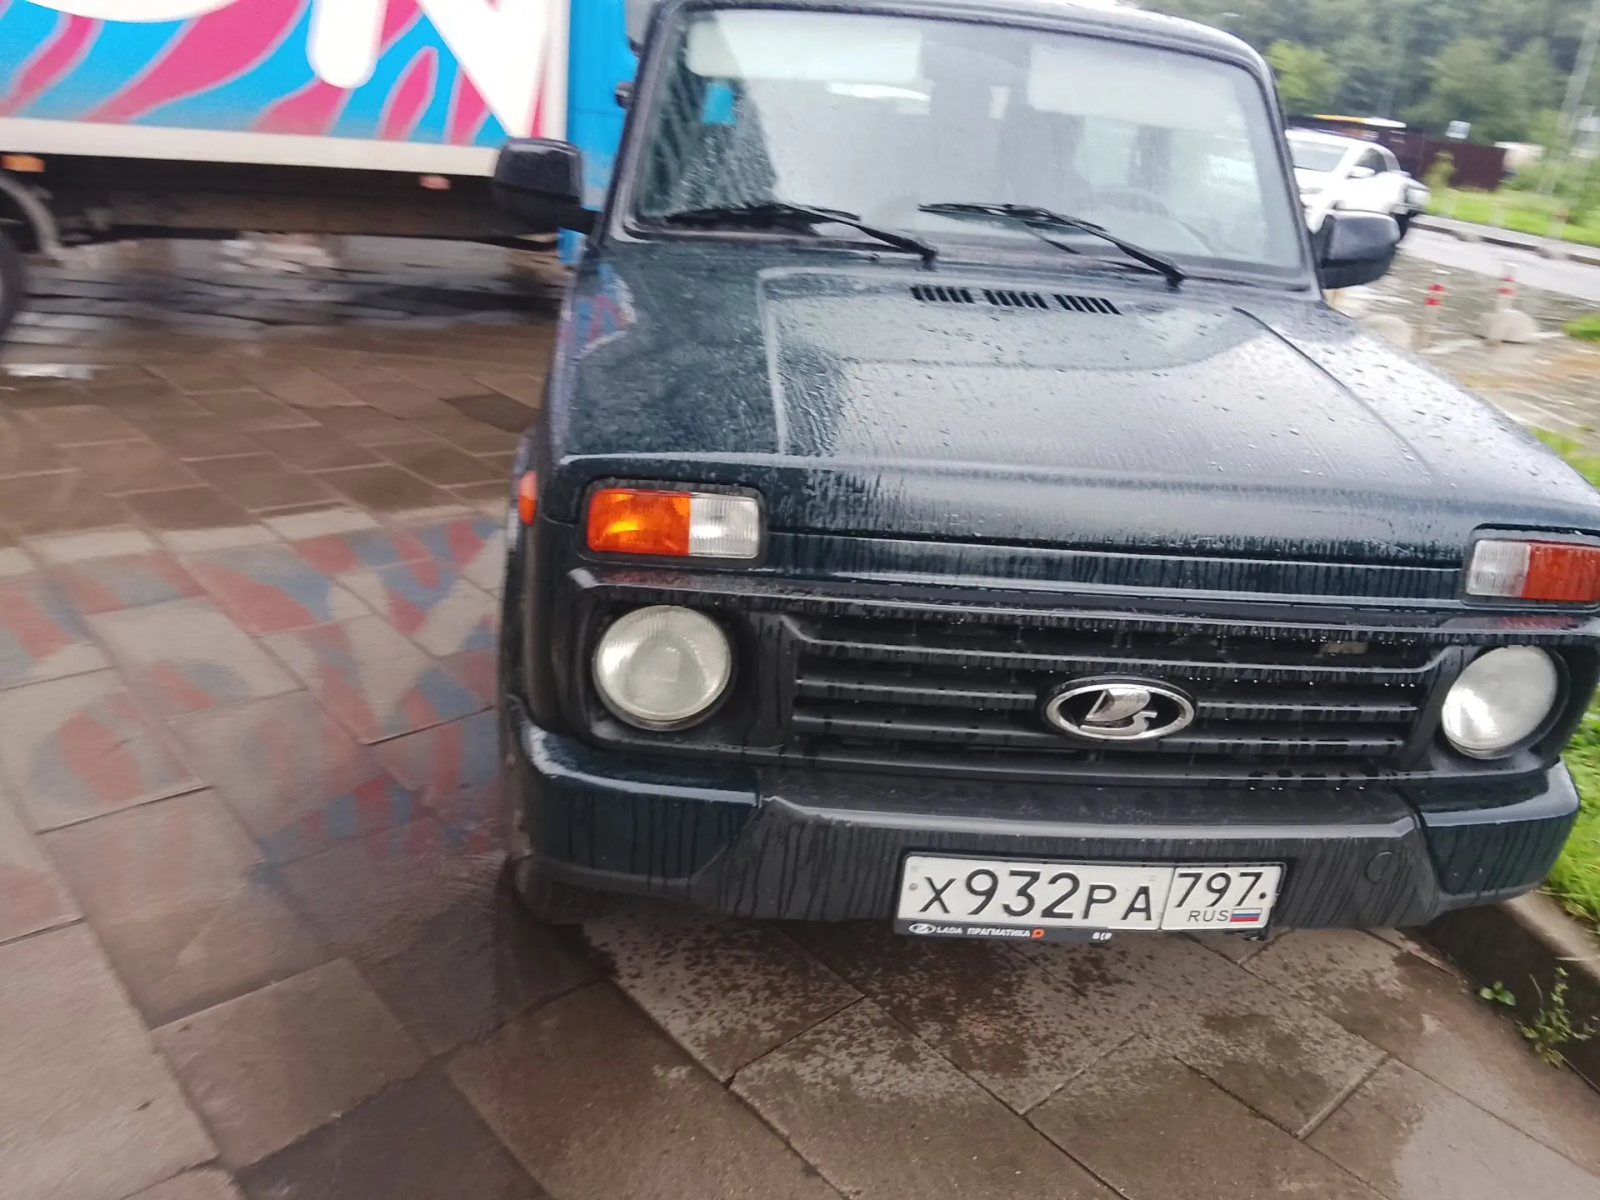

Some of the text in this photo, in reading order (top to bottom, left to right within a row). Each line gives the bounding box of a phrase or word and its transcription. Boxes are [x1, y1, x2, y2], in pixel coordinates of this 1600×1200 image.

[1174, 871, 1264, 908] 797
[1187, 909, 1229, 923] RUS
[936, 926, 1031, 937] LADA ПРАГМАТИКА
